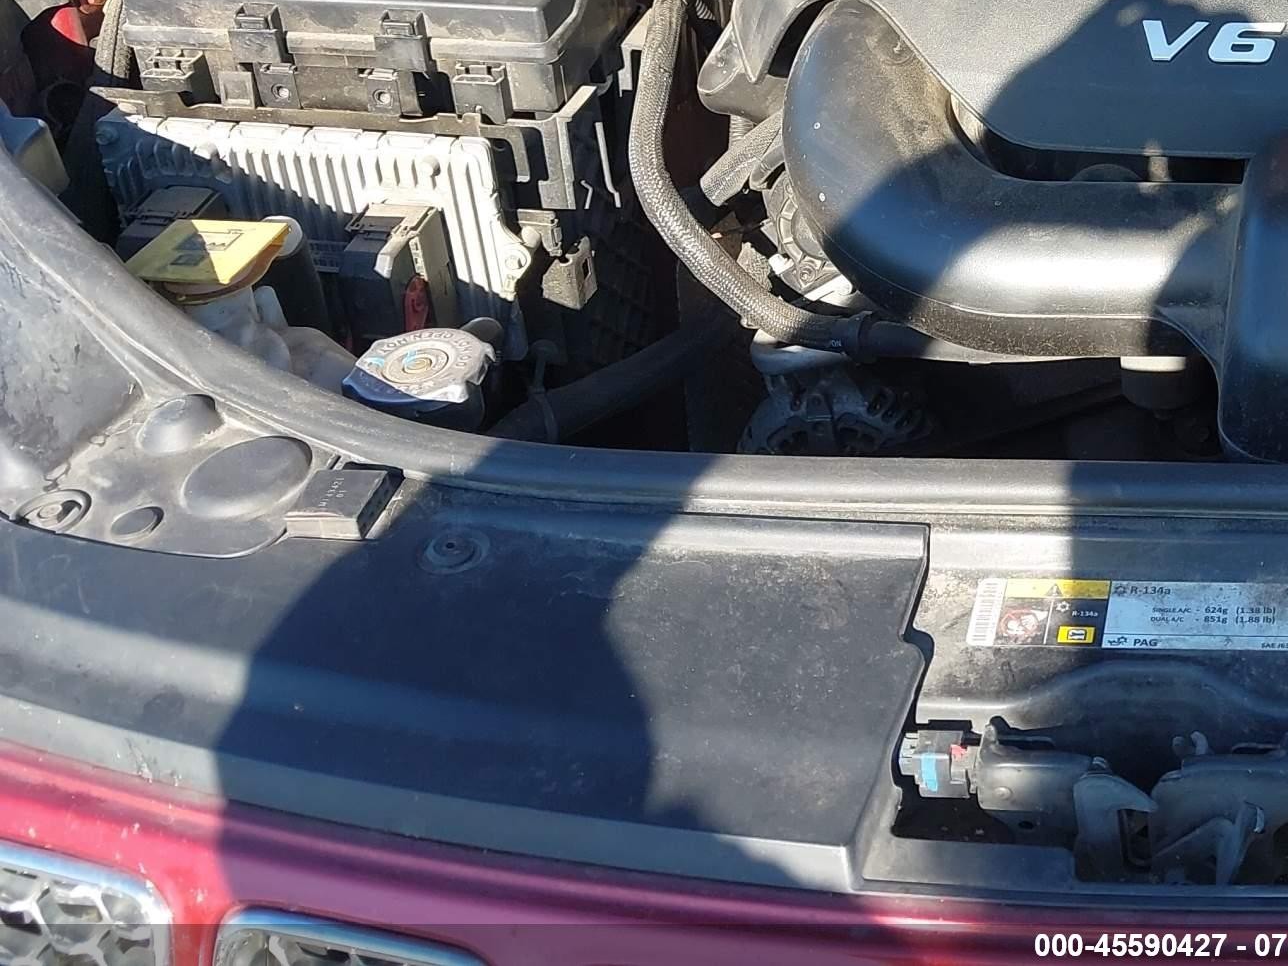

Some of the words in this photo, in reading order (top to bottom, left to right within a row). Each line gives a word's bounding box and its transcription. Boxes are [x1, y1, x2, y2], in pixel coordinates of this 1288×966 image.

[1142, 20, 1287, 64] V6
[1129, 586, 1171, 595] R-134a
[1204, 606, 1229, 615] 624g
[1263, 606, 1276, 615] lb)
[1203, 616, 1228, 624] 851g
[1235, 616, 1260, 624] (1.88
[1262, 616, 1276, 624] lb)
[1133, 639, 1158, 647] PAG
